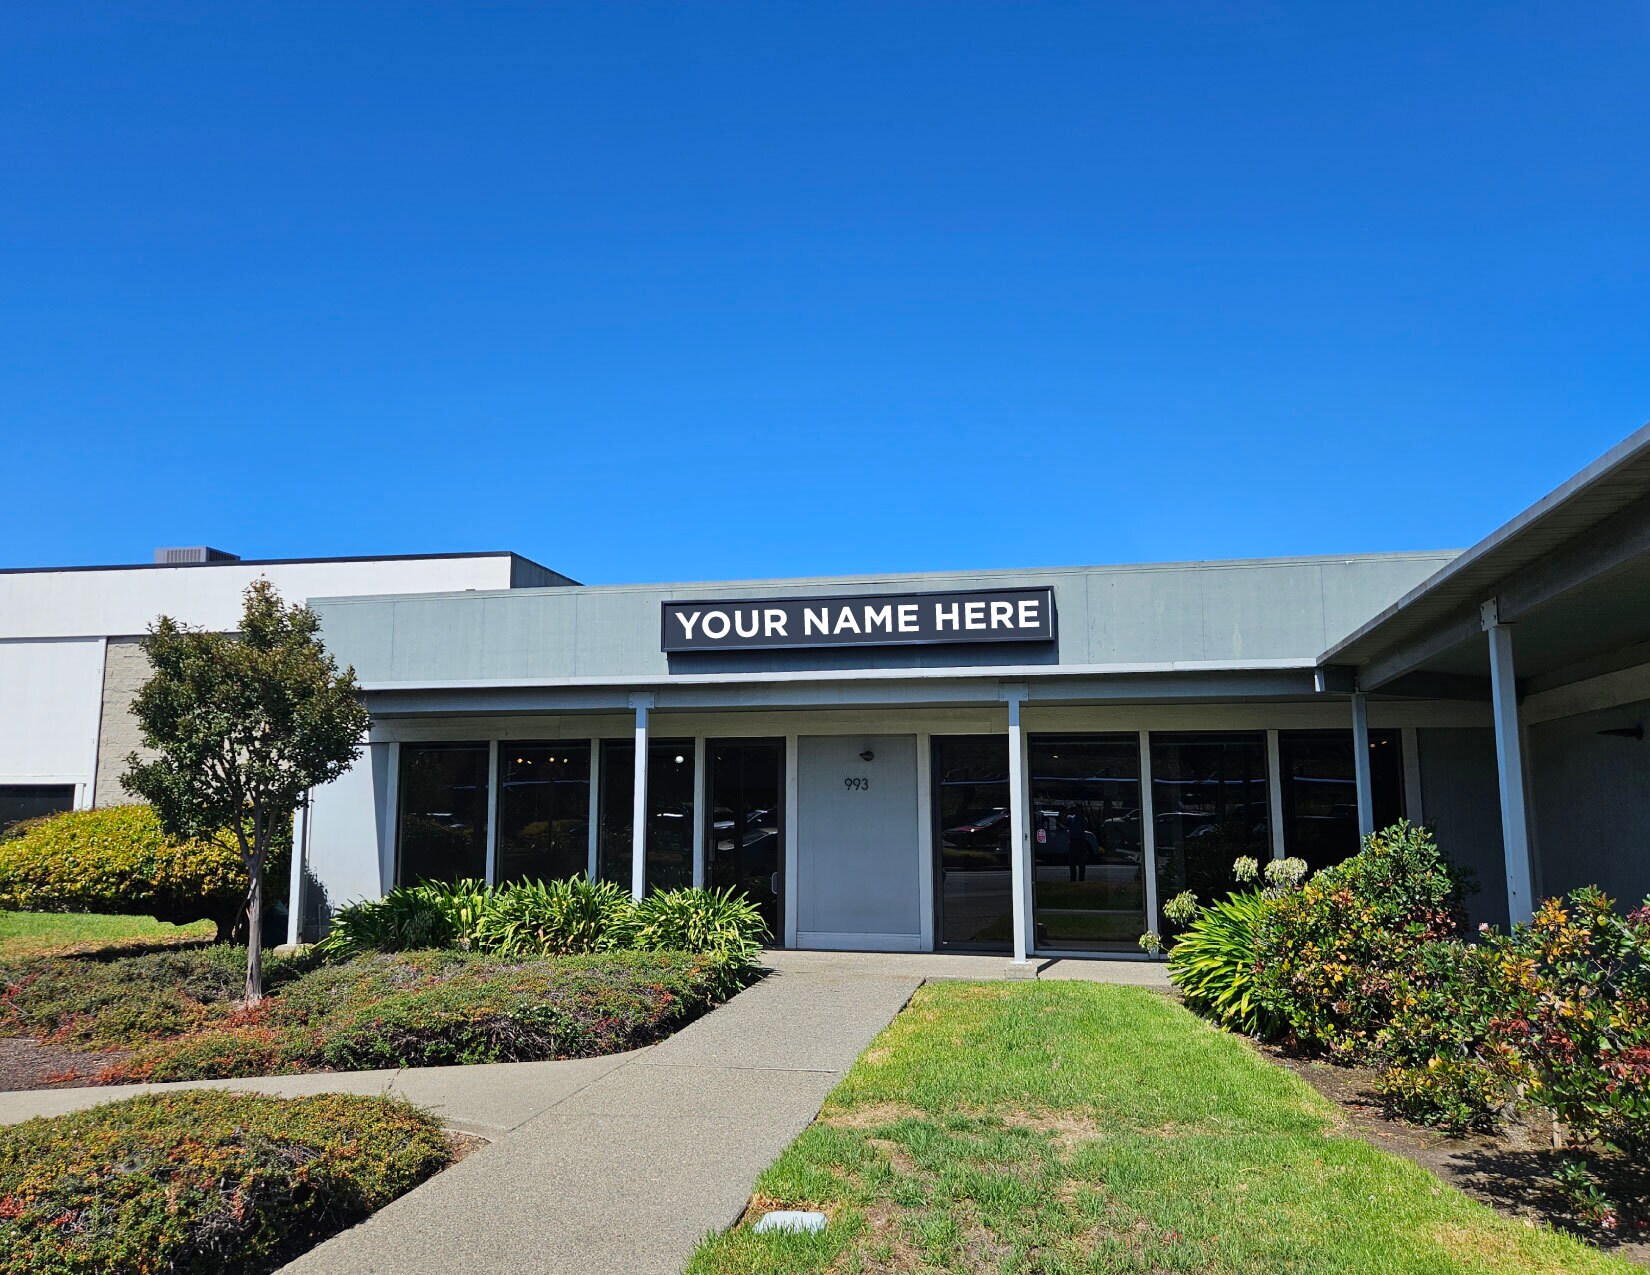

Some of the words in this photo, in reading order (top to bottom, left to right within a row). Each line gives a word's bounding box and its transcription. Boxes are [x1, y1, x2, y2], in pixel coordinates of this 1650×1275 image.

[675, 609, 788, 640] YOUR
[804, 604, 919, 635] NAME
[935, 600, 1040, 631] HERE
[844, 777, 869, 791] 993
